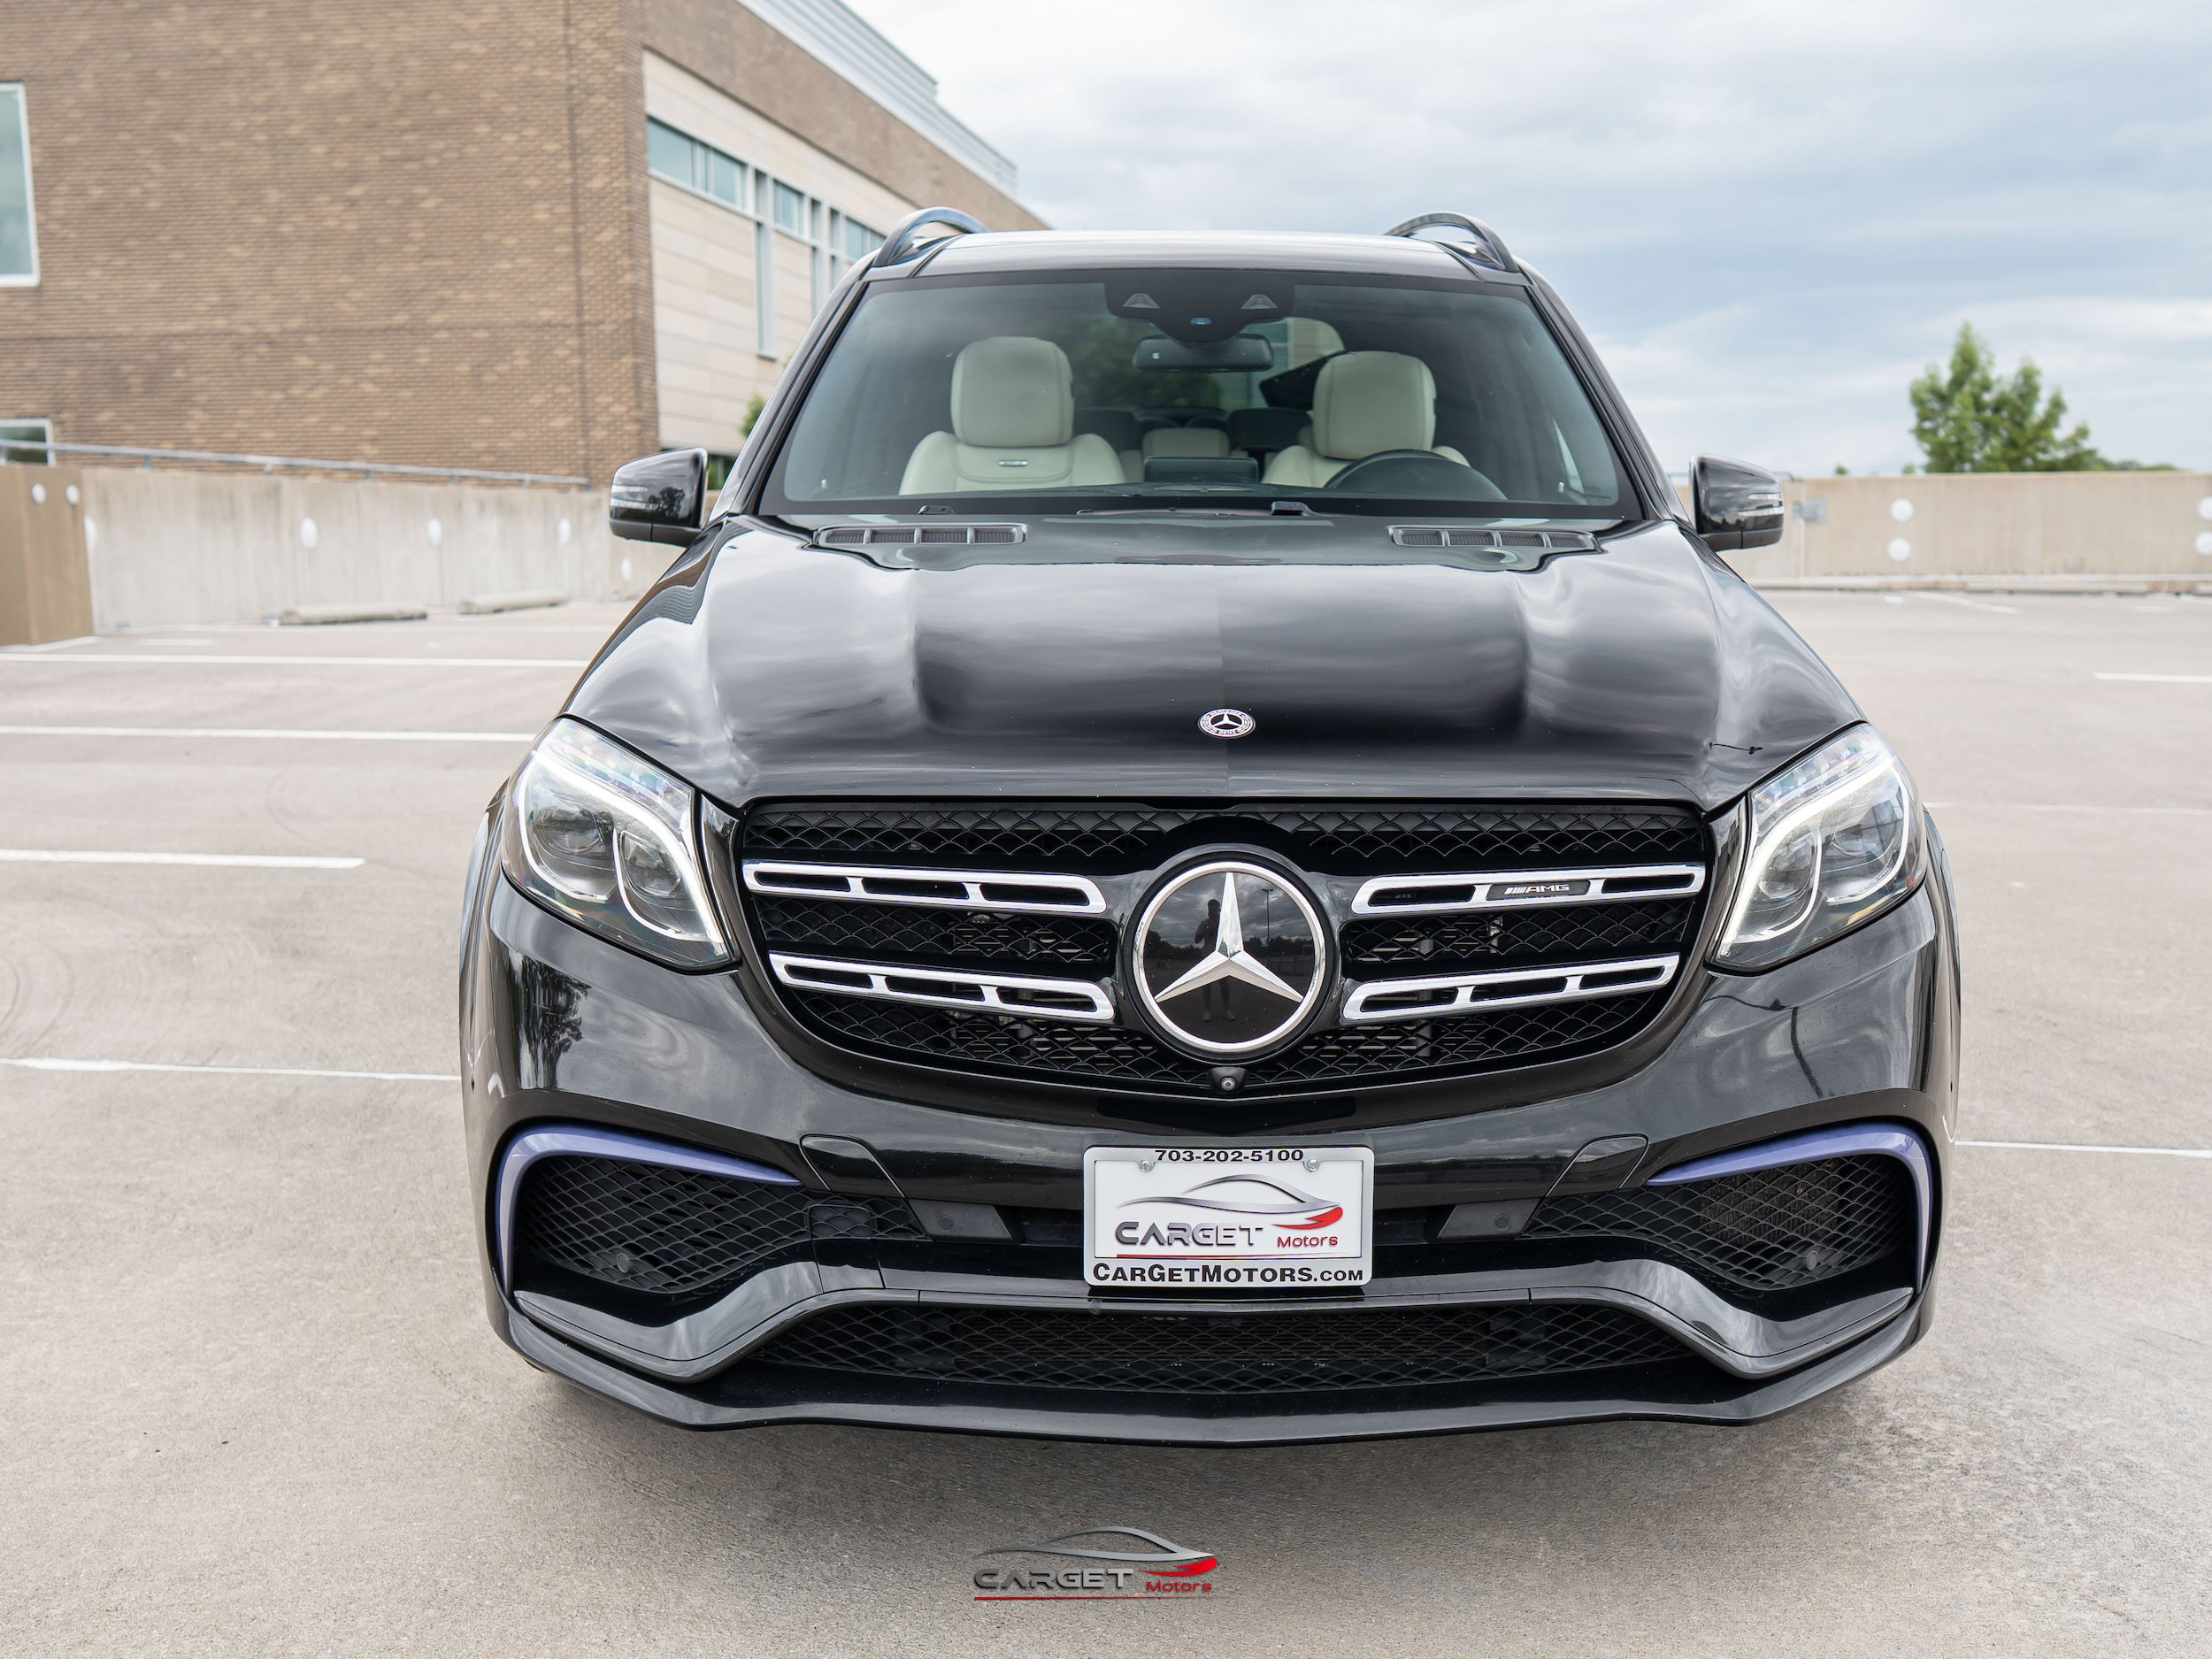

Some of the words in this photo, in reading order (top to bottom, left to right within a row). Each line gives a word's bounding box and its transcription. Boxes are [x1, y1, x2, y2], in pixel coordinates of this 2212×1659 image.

[1155, 1148, 1304, 1162] 703-202-5100
[1115, 1221, 1263, 1247] CARGET
[1277, 1234, 1339, 1248] Motors
